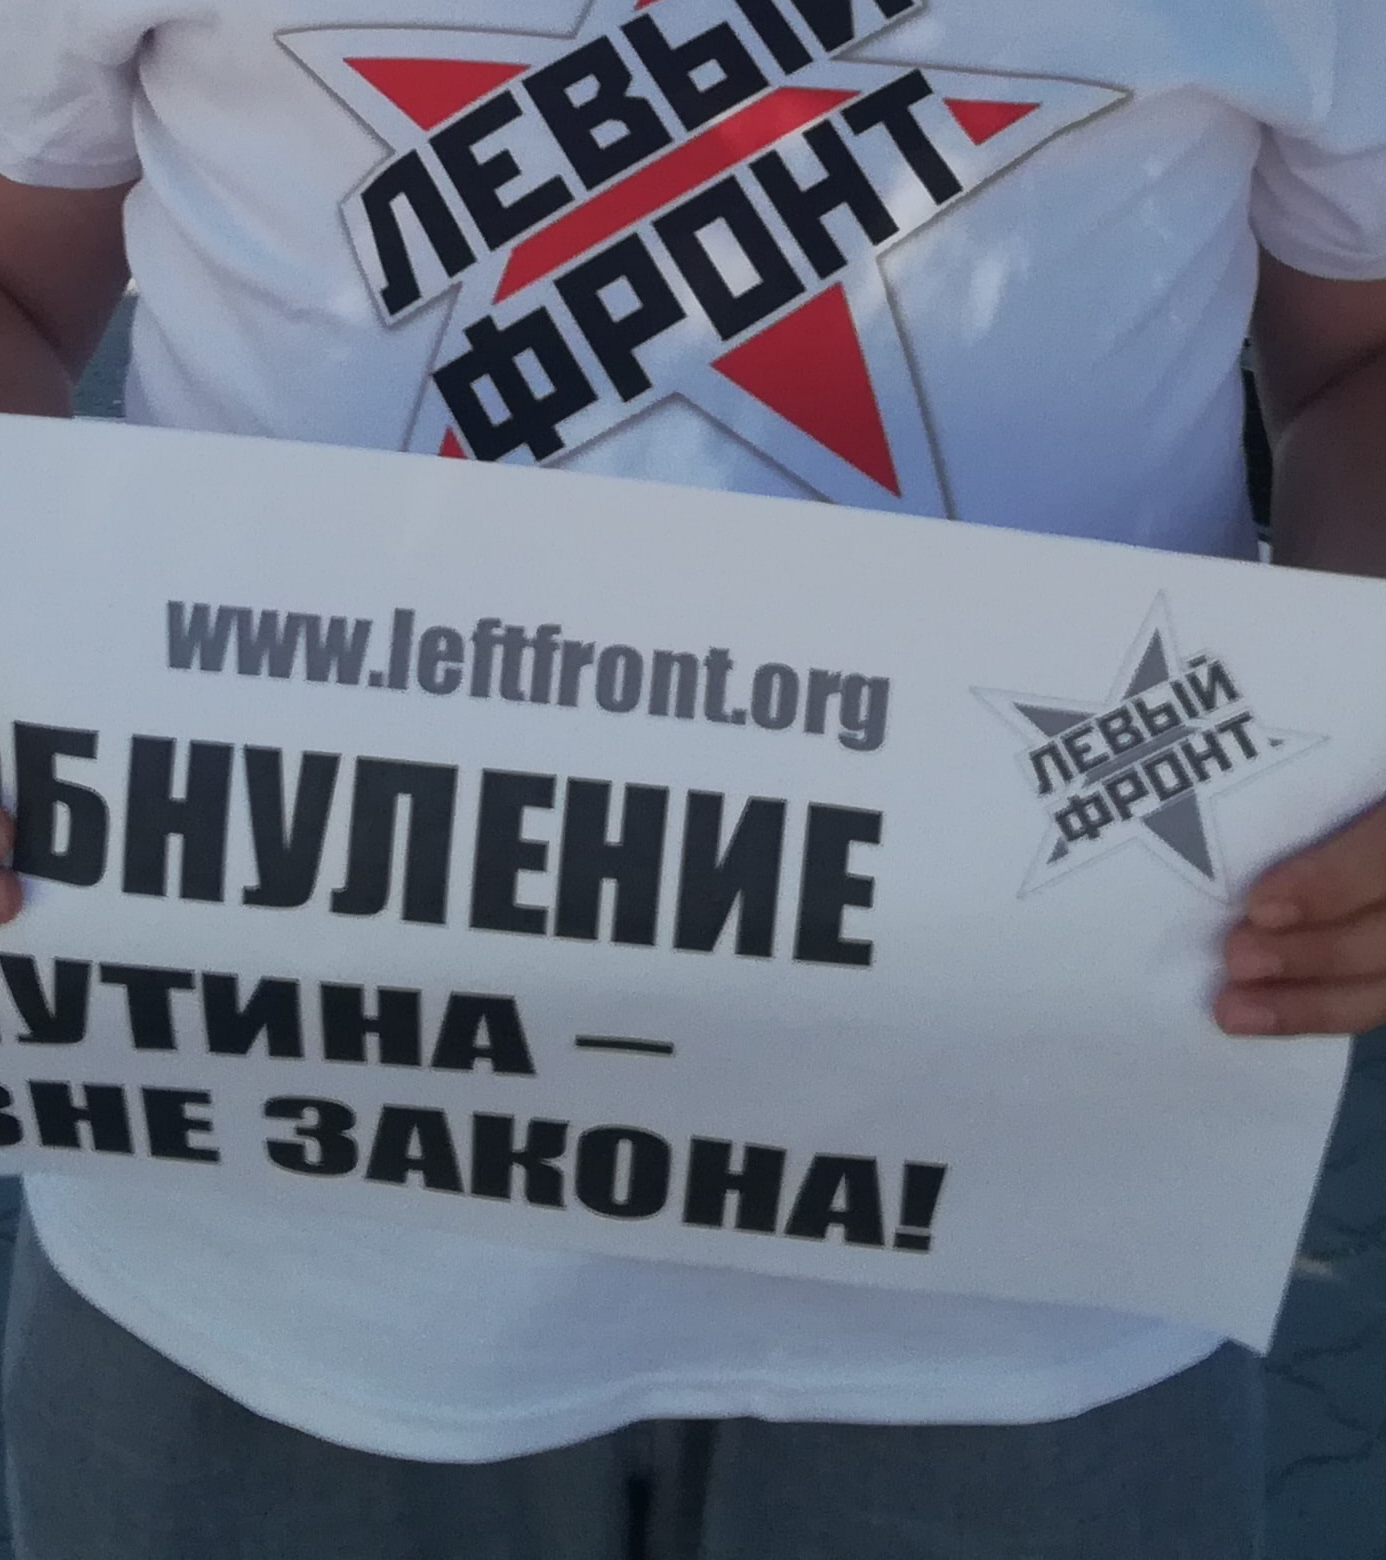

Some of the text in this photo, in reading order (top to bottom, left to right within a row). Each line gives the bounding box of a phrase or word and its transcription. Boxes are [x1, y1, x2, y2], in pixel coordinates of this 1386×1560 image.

[431, 68, 965, 463] ФРОНТ
[167, 600, 890, 752] www.leftfront.org
[1029, 654, 1242, 795] ЛЕВЫЙ
[1054, 711, 1254, 841] ФРОНТ
[262, 1094, 948, 1253] ЗАКОНА!
